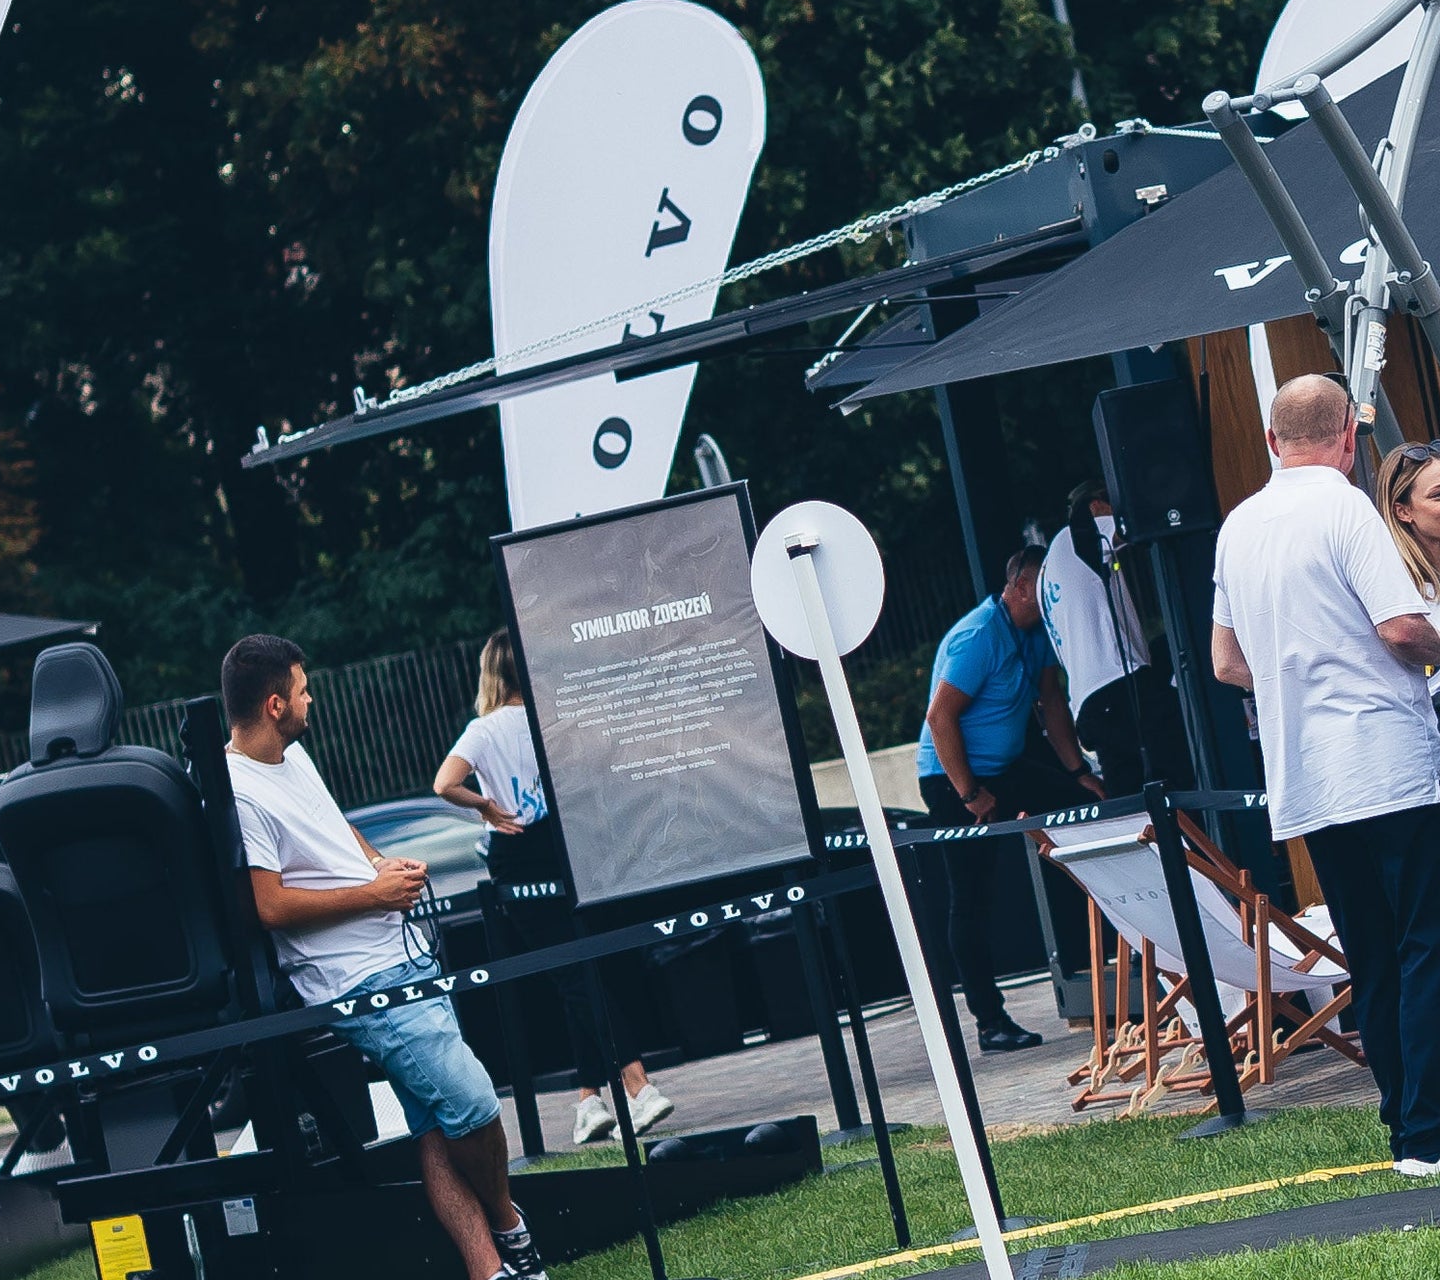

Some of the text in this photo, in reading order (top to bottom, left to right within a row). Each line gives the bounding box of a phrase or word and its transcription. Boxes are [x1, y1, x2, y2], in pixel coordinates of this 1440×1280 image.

[592, 94, 723, 472] OVO
[570, 592, 712, 642] SYMULATOR ZDERZEŃ
[1045, 805, 1099, 826] VOLVO
[825, 834, 871, 849] VOLV
[934, 826, 989, 840] VOLVO
[513, 883, 557, 898] VOLVO
[409, 898, 451, 918] VOLVO
[654, 886, 805, 936] VOLVO
[333, 969, 488, 1017] VOLVO
